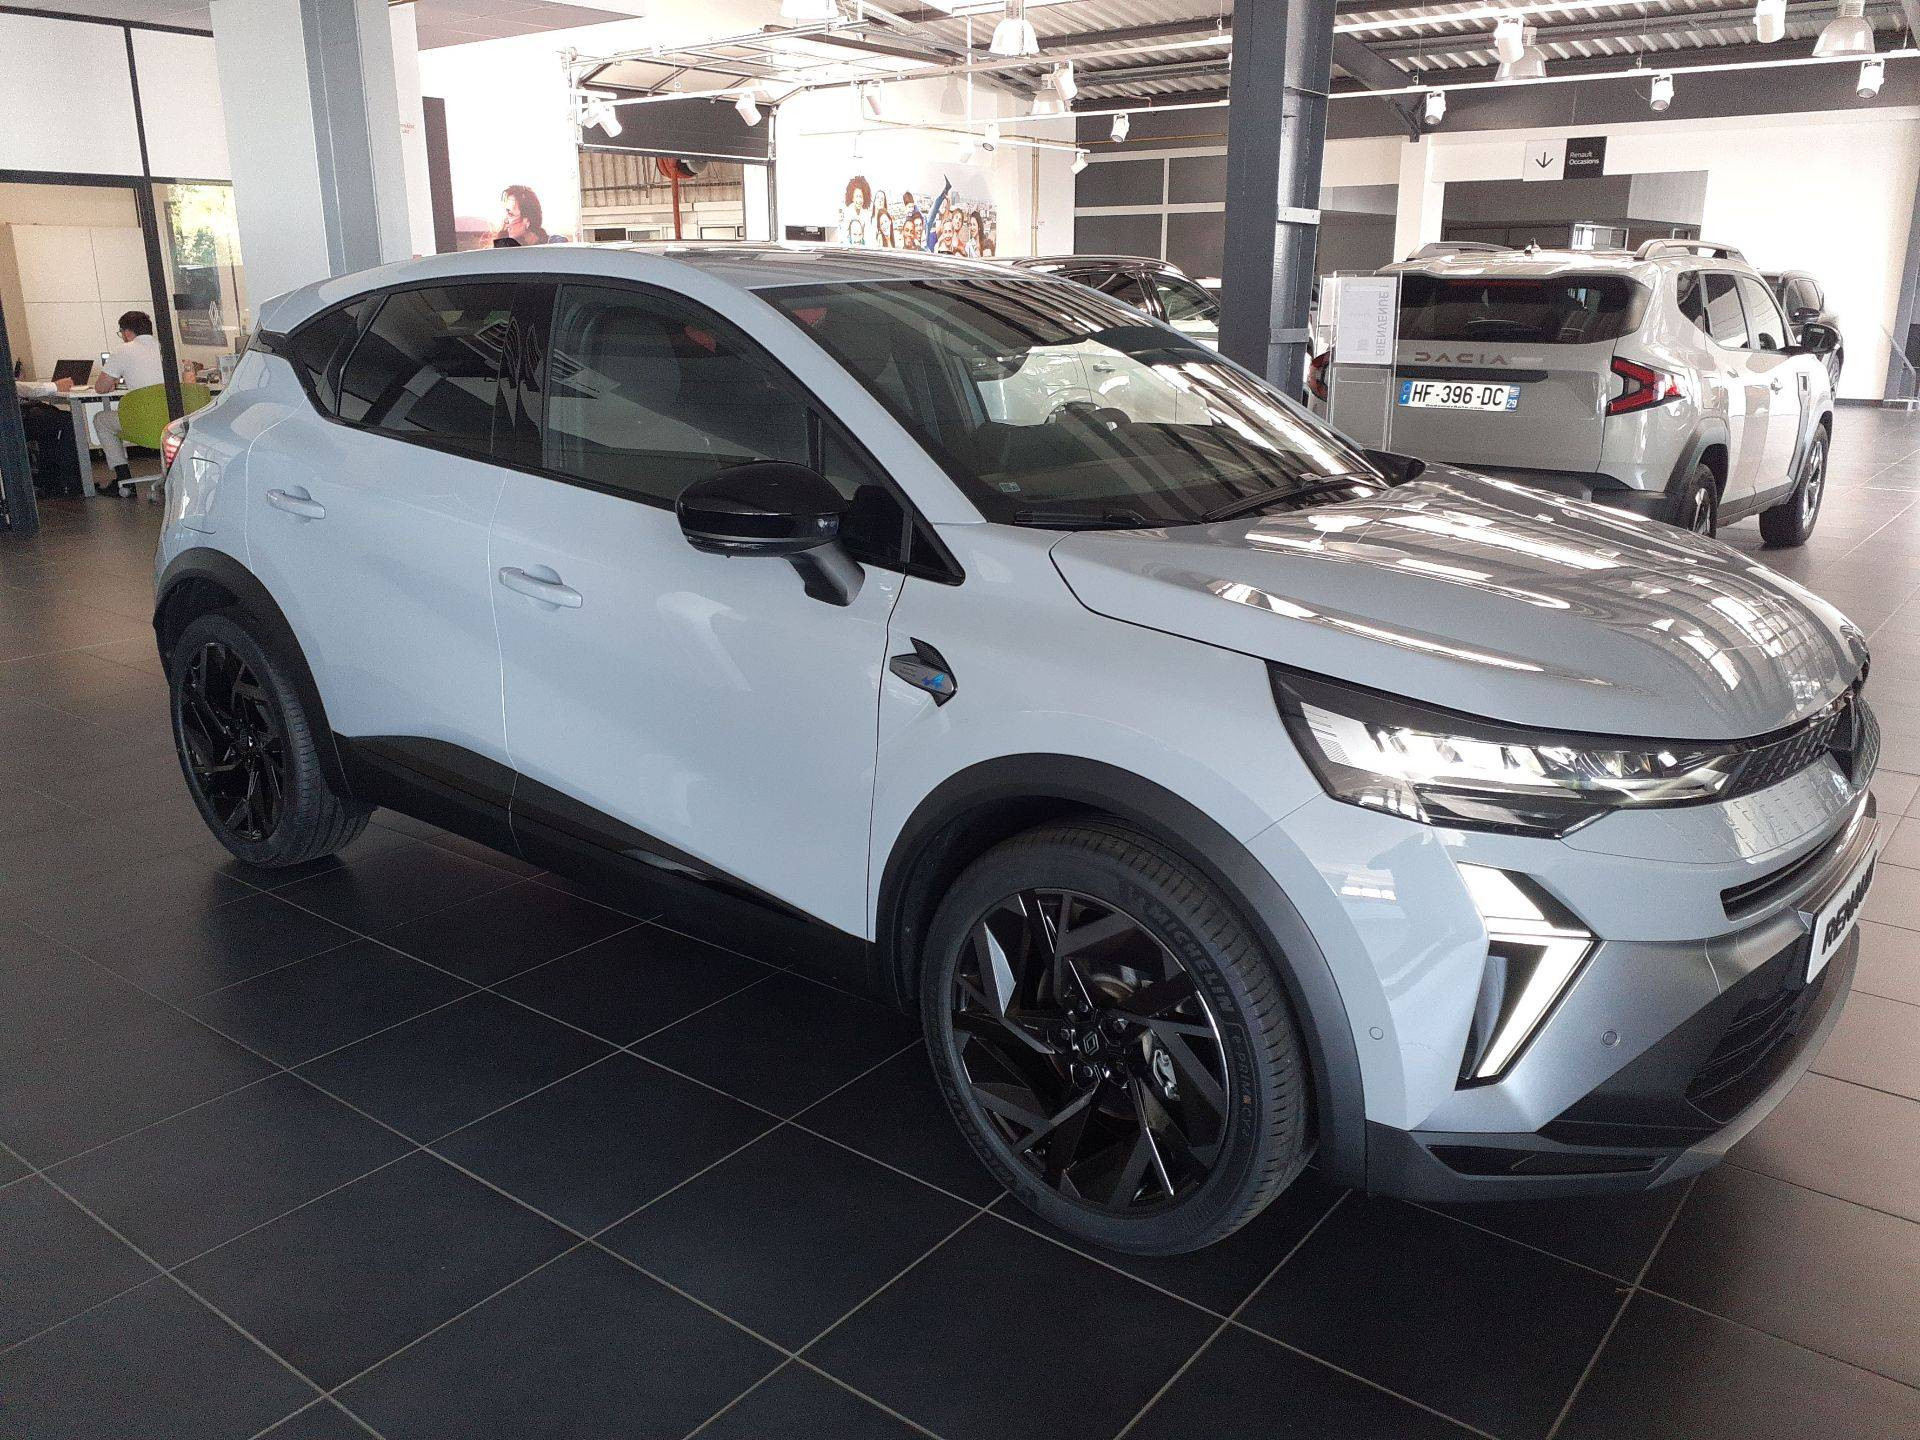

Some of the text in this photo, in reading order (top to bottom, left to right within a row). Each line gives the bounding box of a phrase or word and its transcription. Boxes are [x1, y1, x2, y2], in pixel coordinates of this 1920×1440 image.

[1568, 158, 1600, 166] Occasions
[1415, 351, 1508, 366] DACIA
[1411, 384, 1504, 407] HF-396-DC
[1507, 399, 1517, 408] 29
[1145, 900, 1236, 1013] MICHELIN
